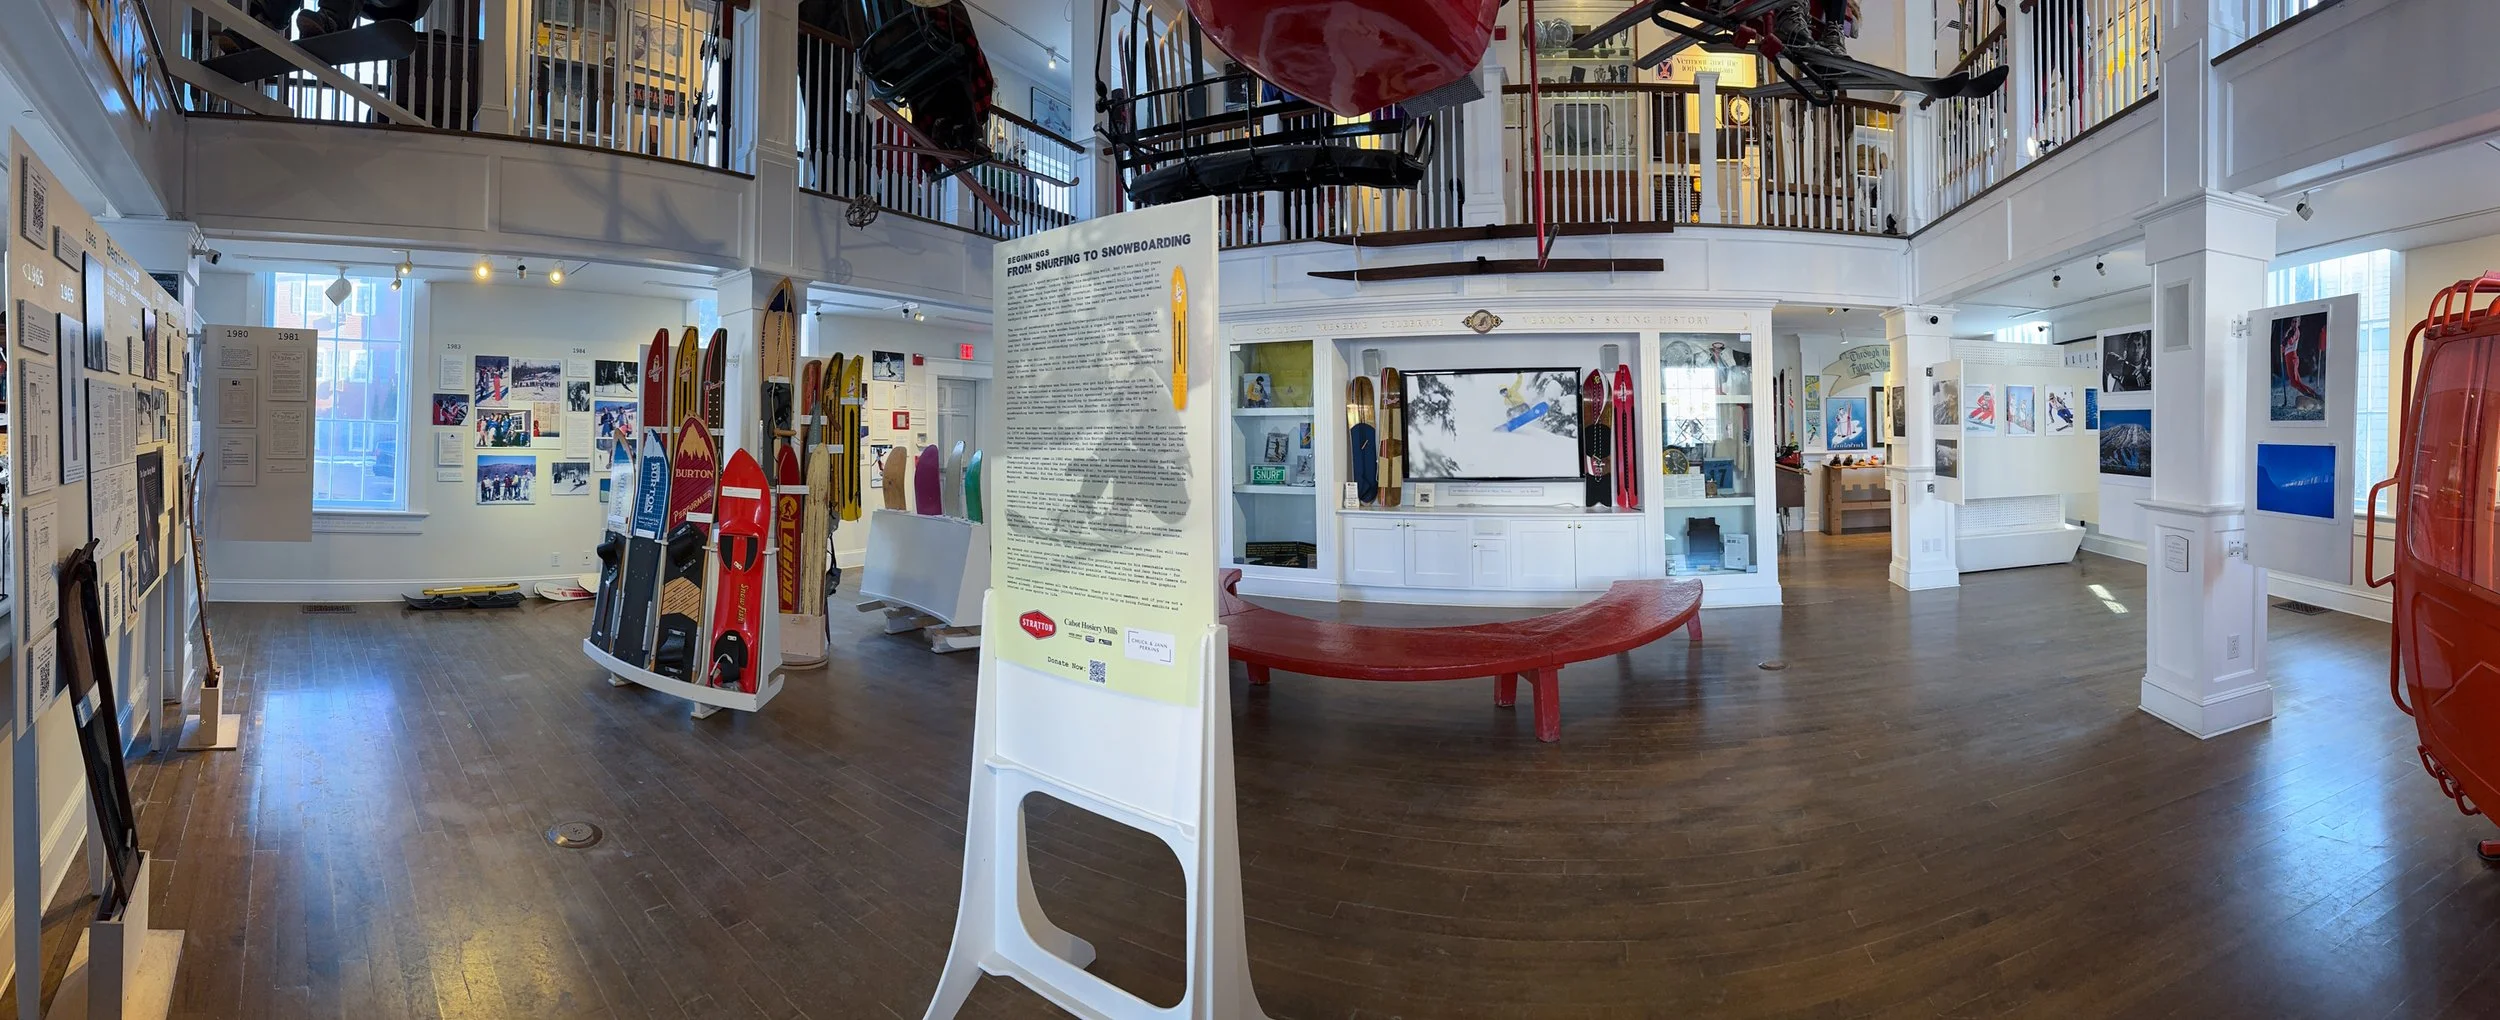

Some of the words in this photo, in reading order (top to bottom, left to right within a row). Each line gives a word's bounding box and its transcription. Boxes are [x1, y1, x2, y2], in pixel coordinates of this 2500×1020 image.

[1007, 248, 1050, 264] BEGINNINGS
[1007, 263, 1032, 278] FROM
[1035, 253, 1080, 272] SNURFING
[1083, 249, 1098, 262] TO
[1101, 234, 1191, 258] SNOWBOARDING
[22, 263, 43, 287] <1965
[60, 283, 74, 303] 1965
[1660, 316, 1710, 324] HISTORY
[226, 330, 249, 338] 1980
[278, 332, 300, 341] 1981
[1849, 348, 1880, 362] Through
[675, 468, 714, 478] BURTON
[1256, 470, 1281, 479] SNURF
[644, 462, 660, 513] BURTON
[1022, 618, 1054, 632] STRATTON
[1063, 618, 1081, 628] Cabot
[1081, 621, 1102, 634] Hosiery
[1103, 626, 1118, 635] Mills
[1131, 637, 1148, 645] CHUCK
[1154, 641, 1168, 649] JANN
[1139, 645, 1160, 653] PERKINS
[1047, 656, 1069, 668] Donate
[1071, 662, 1086, 672] Now:
